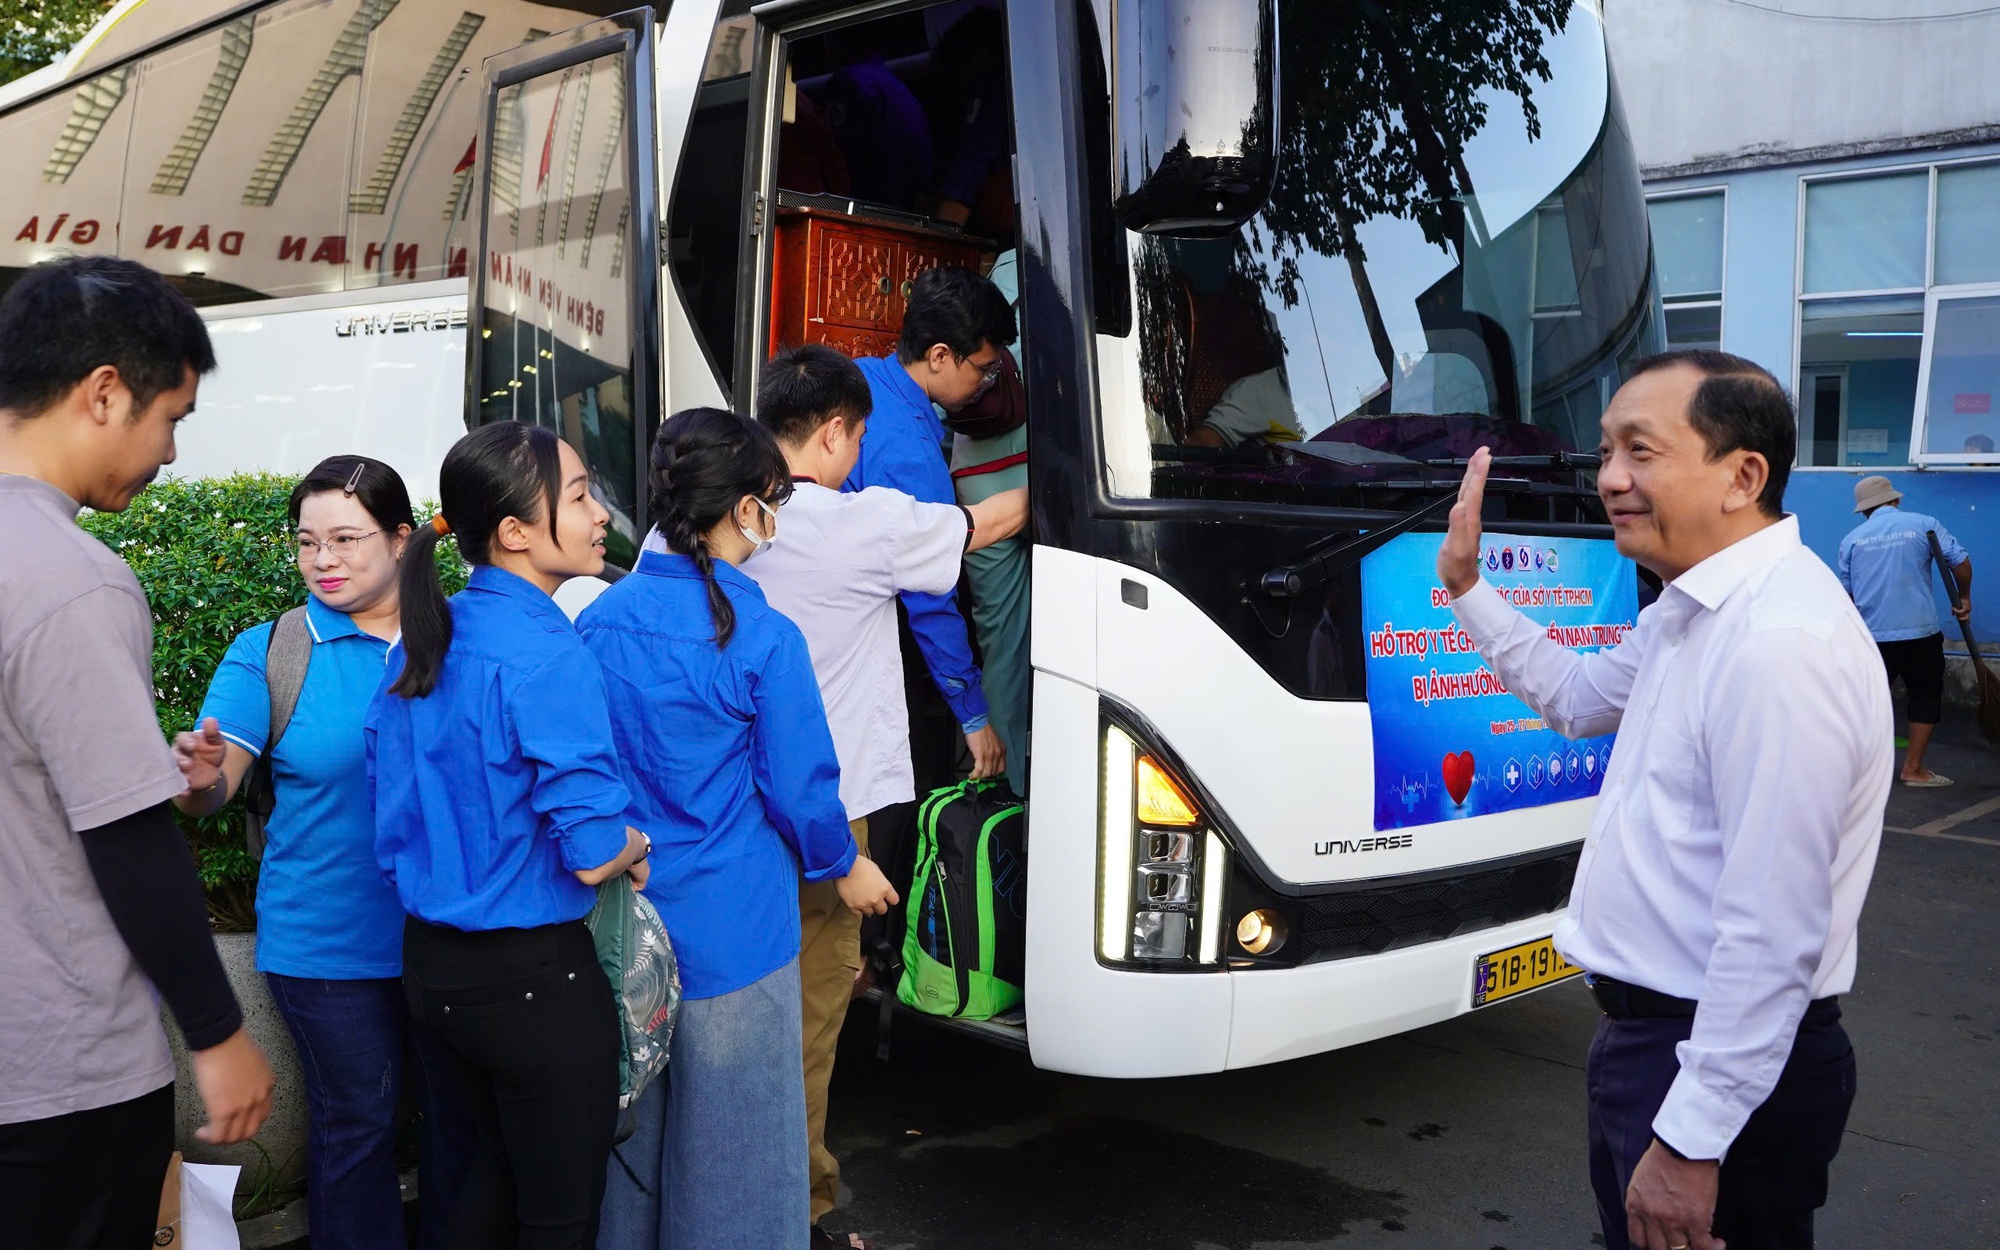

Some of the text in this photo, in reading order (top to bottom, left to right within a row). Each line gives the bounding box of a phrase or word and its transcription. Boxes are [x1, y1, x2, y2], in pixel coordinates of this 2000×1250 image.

[335, 307, 467, 337] UNIVERSE
[1431, 585, 1593, 607] ĐO ÁC CỦA SỞ Y TẾ TP.HCM
[1371, 623, 1396, 656] HỖ
[1396, 629, 1428, 660] TRỢ
[1429, 631, 1438, 653] Y
[1440, 624, 1457, 652] TẾ
[1457, 630, 1476, 652] CH
[1565, 627, 1594, 647] NAM
[1592, 626, 1622, 645] TRUNG
[1413, 677, 1429, 706] BỊ
[1430, 669, 1460, 699] ẢNH
[1315, 834, 1413, 855] UNIVERSE
[1487, 946, 1574, 993] 51B-191.
